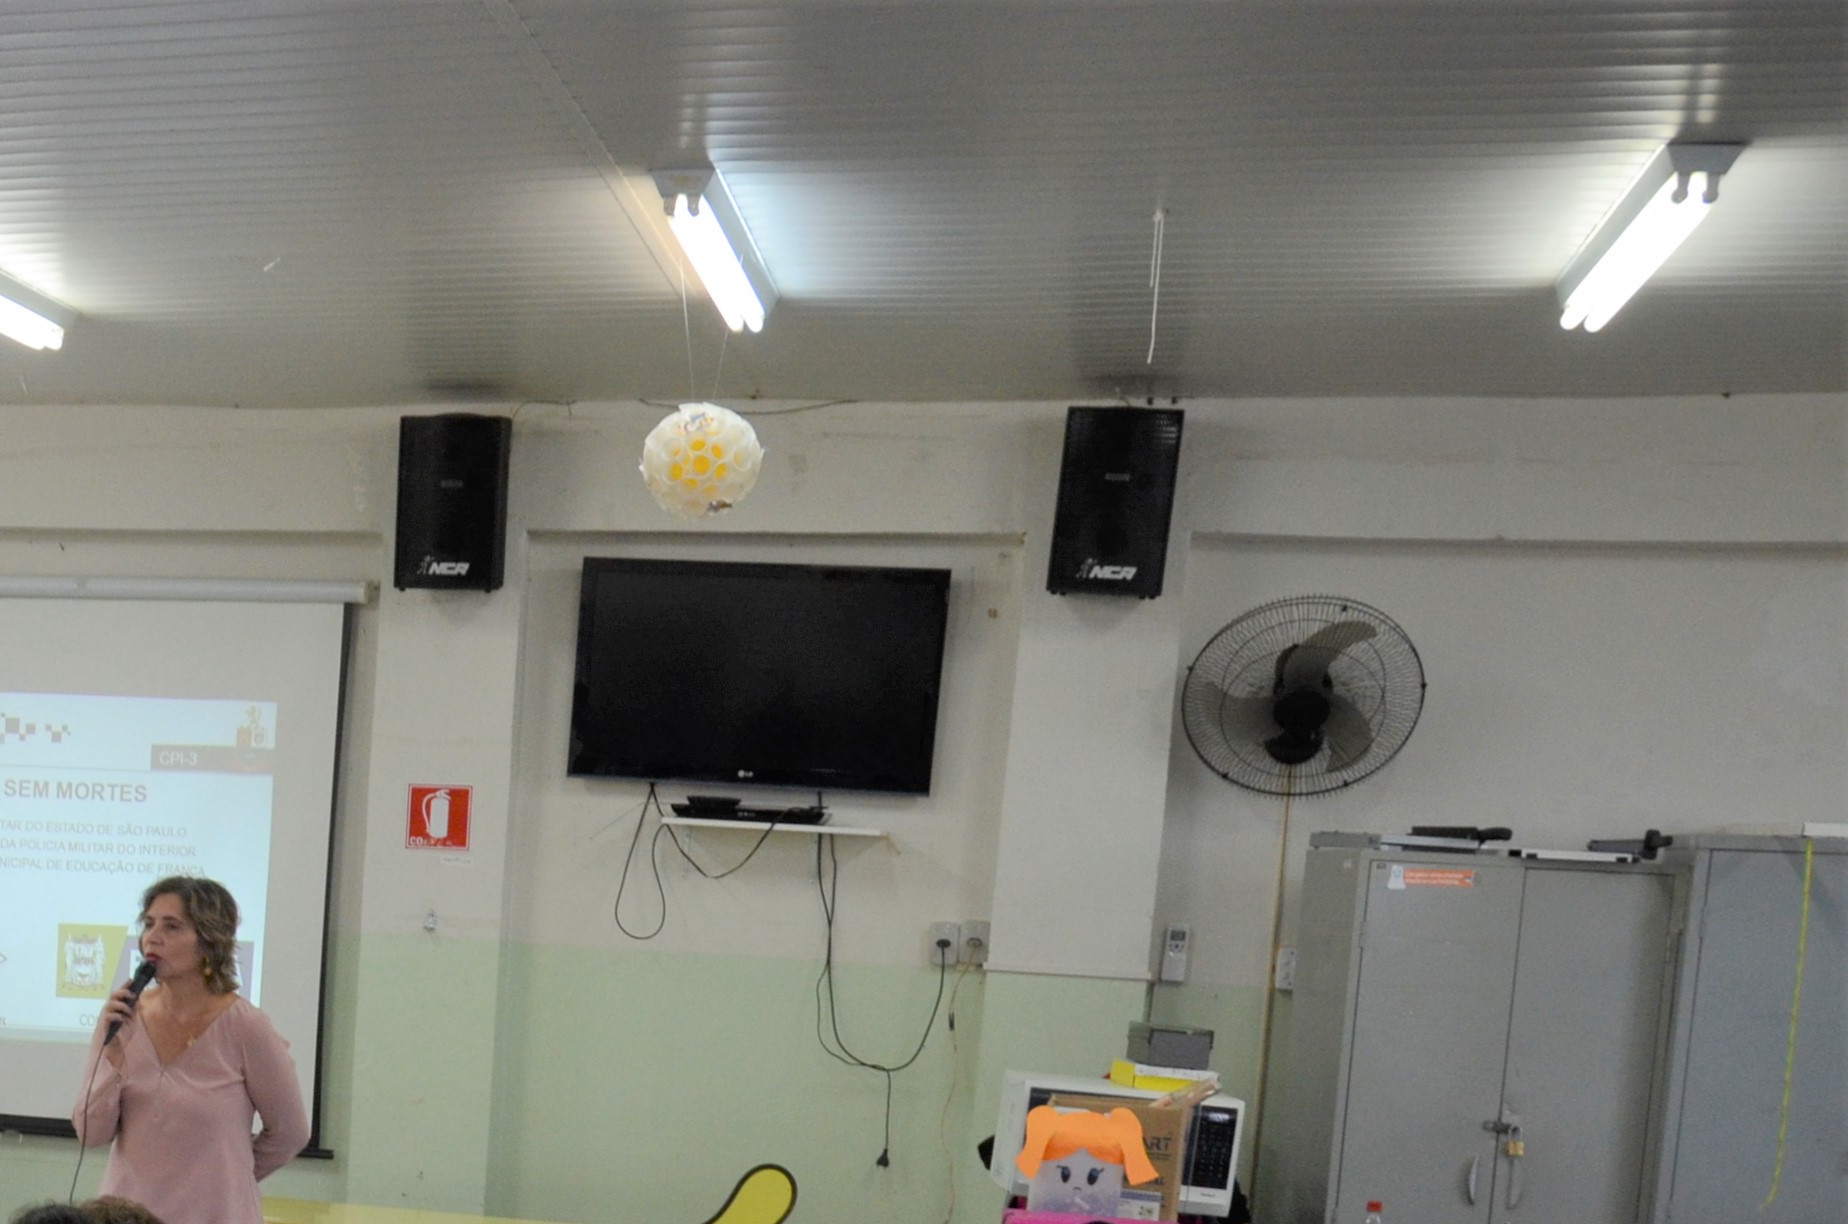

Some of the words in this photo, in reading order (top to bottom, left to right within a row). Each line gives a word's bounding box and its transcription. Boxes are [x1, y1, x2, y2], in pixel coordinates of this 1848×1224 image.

[159, 750, 198, 766] CPI-3
[4, 779, 49, 799] SEM
[56, 781, 148, 802] MORTES
[25, 821, 43, 831] DO
[46, 822, 95, 834] ESTADO
[97, 824, 113, 836] DE
[117, 822, 143, 837] SÃO
[146, 826, 188, 838] PAULO
[0, 839, 16, 849] DA
[68, 842, 114, 854] MILITAR
[117, 844, 135, 855] DO
[139, 844, 196, 857] INTERIOR
[46, 859, 63, 870] DE
[66, 859, 135, 875] EDUCAÇÃO
[138, 862, 154, 873] DE
